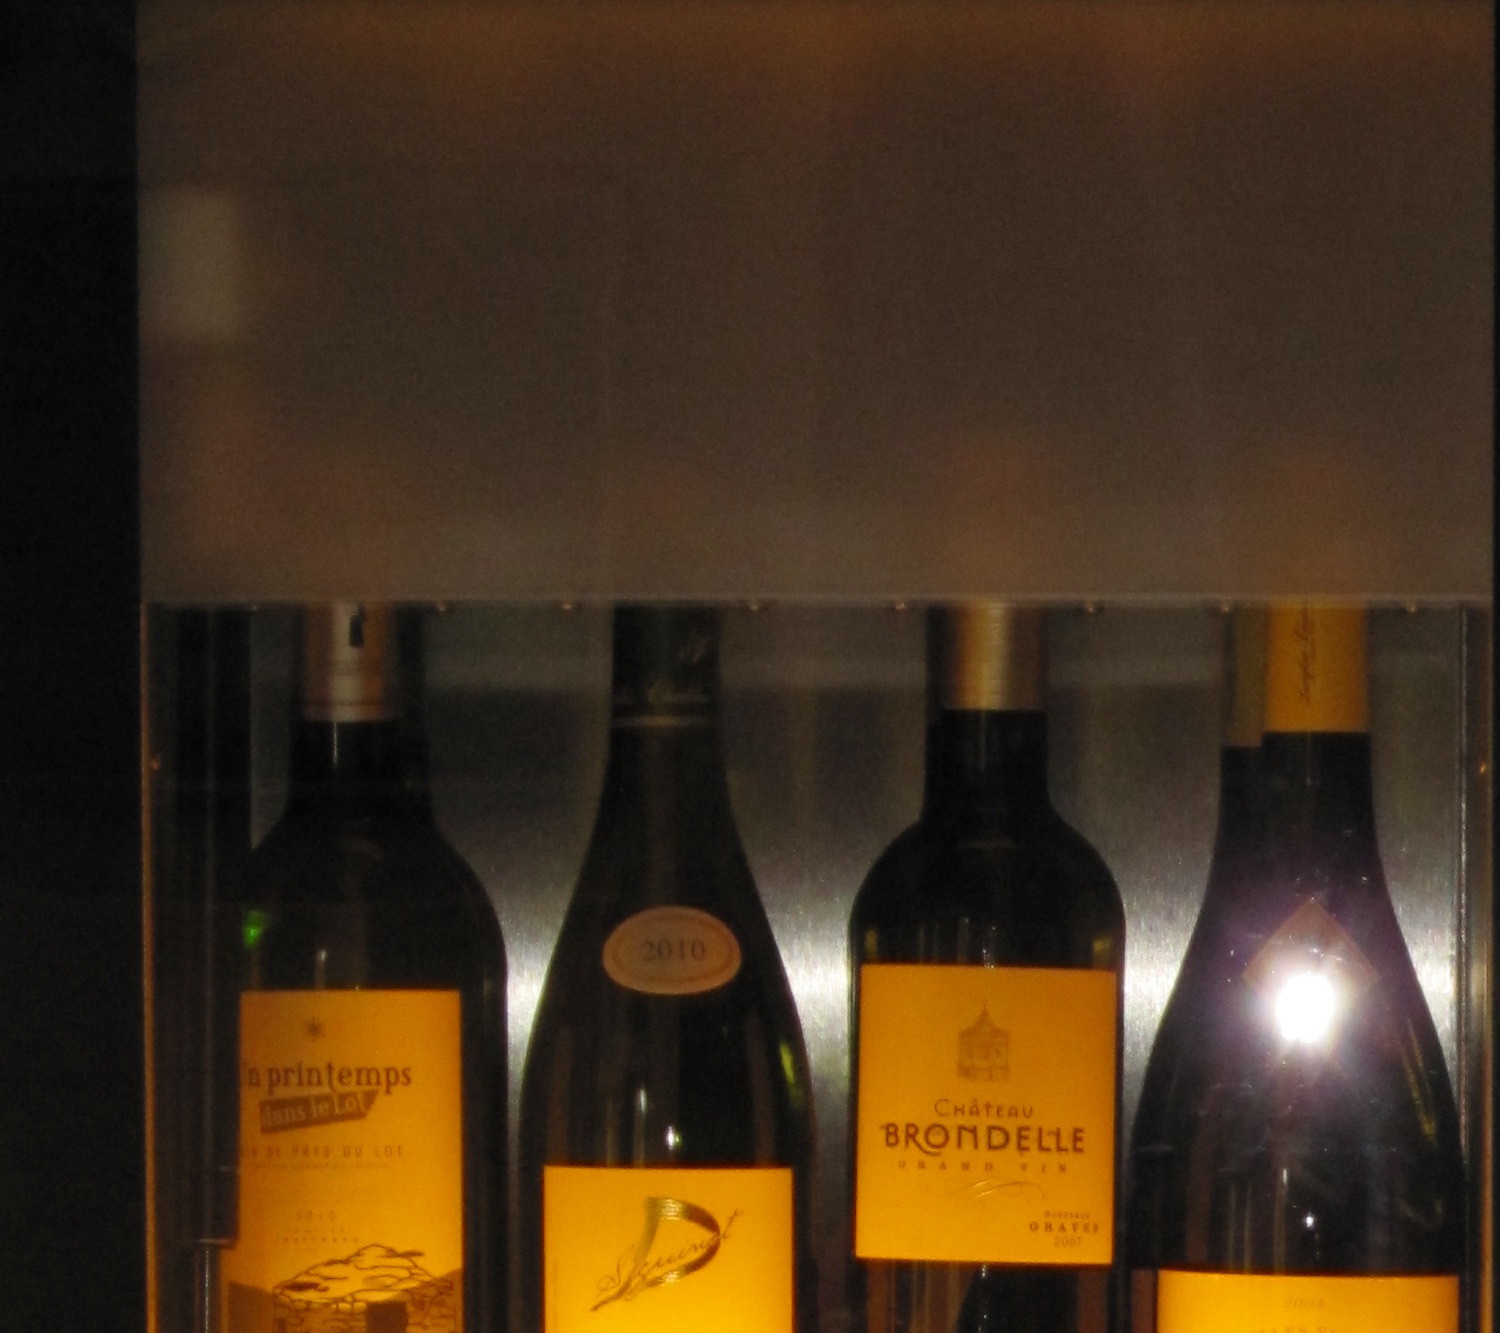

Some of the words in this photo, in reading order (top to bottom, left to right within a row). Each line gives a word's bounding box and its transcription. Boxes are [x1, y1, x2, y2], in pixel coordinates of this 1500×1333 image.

[643, 939, 706, 962] 2010
[267, 1061, 412, 1096] printemps
[881, 1123, 1086, 1157] BRONDELLE
